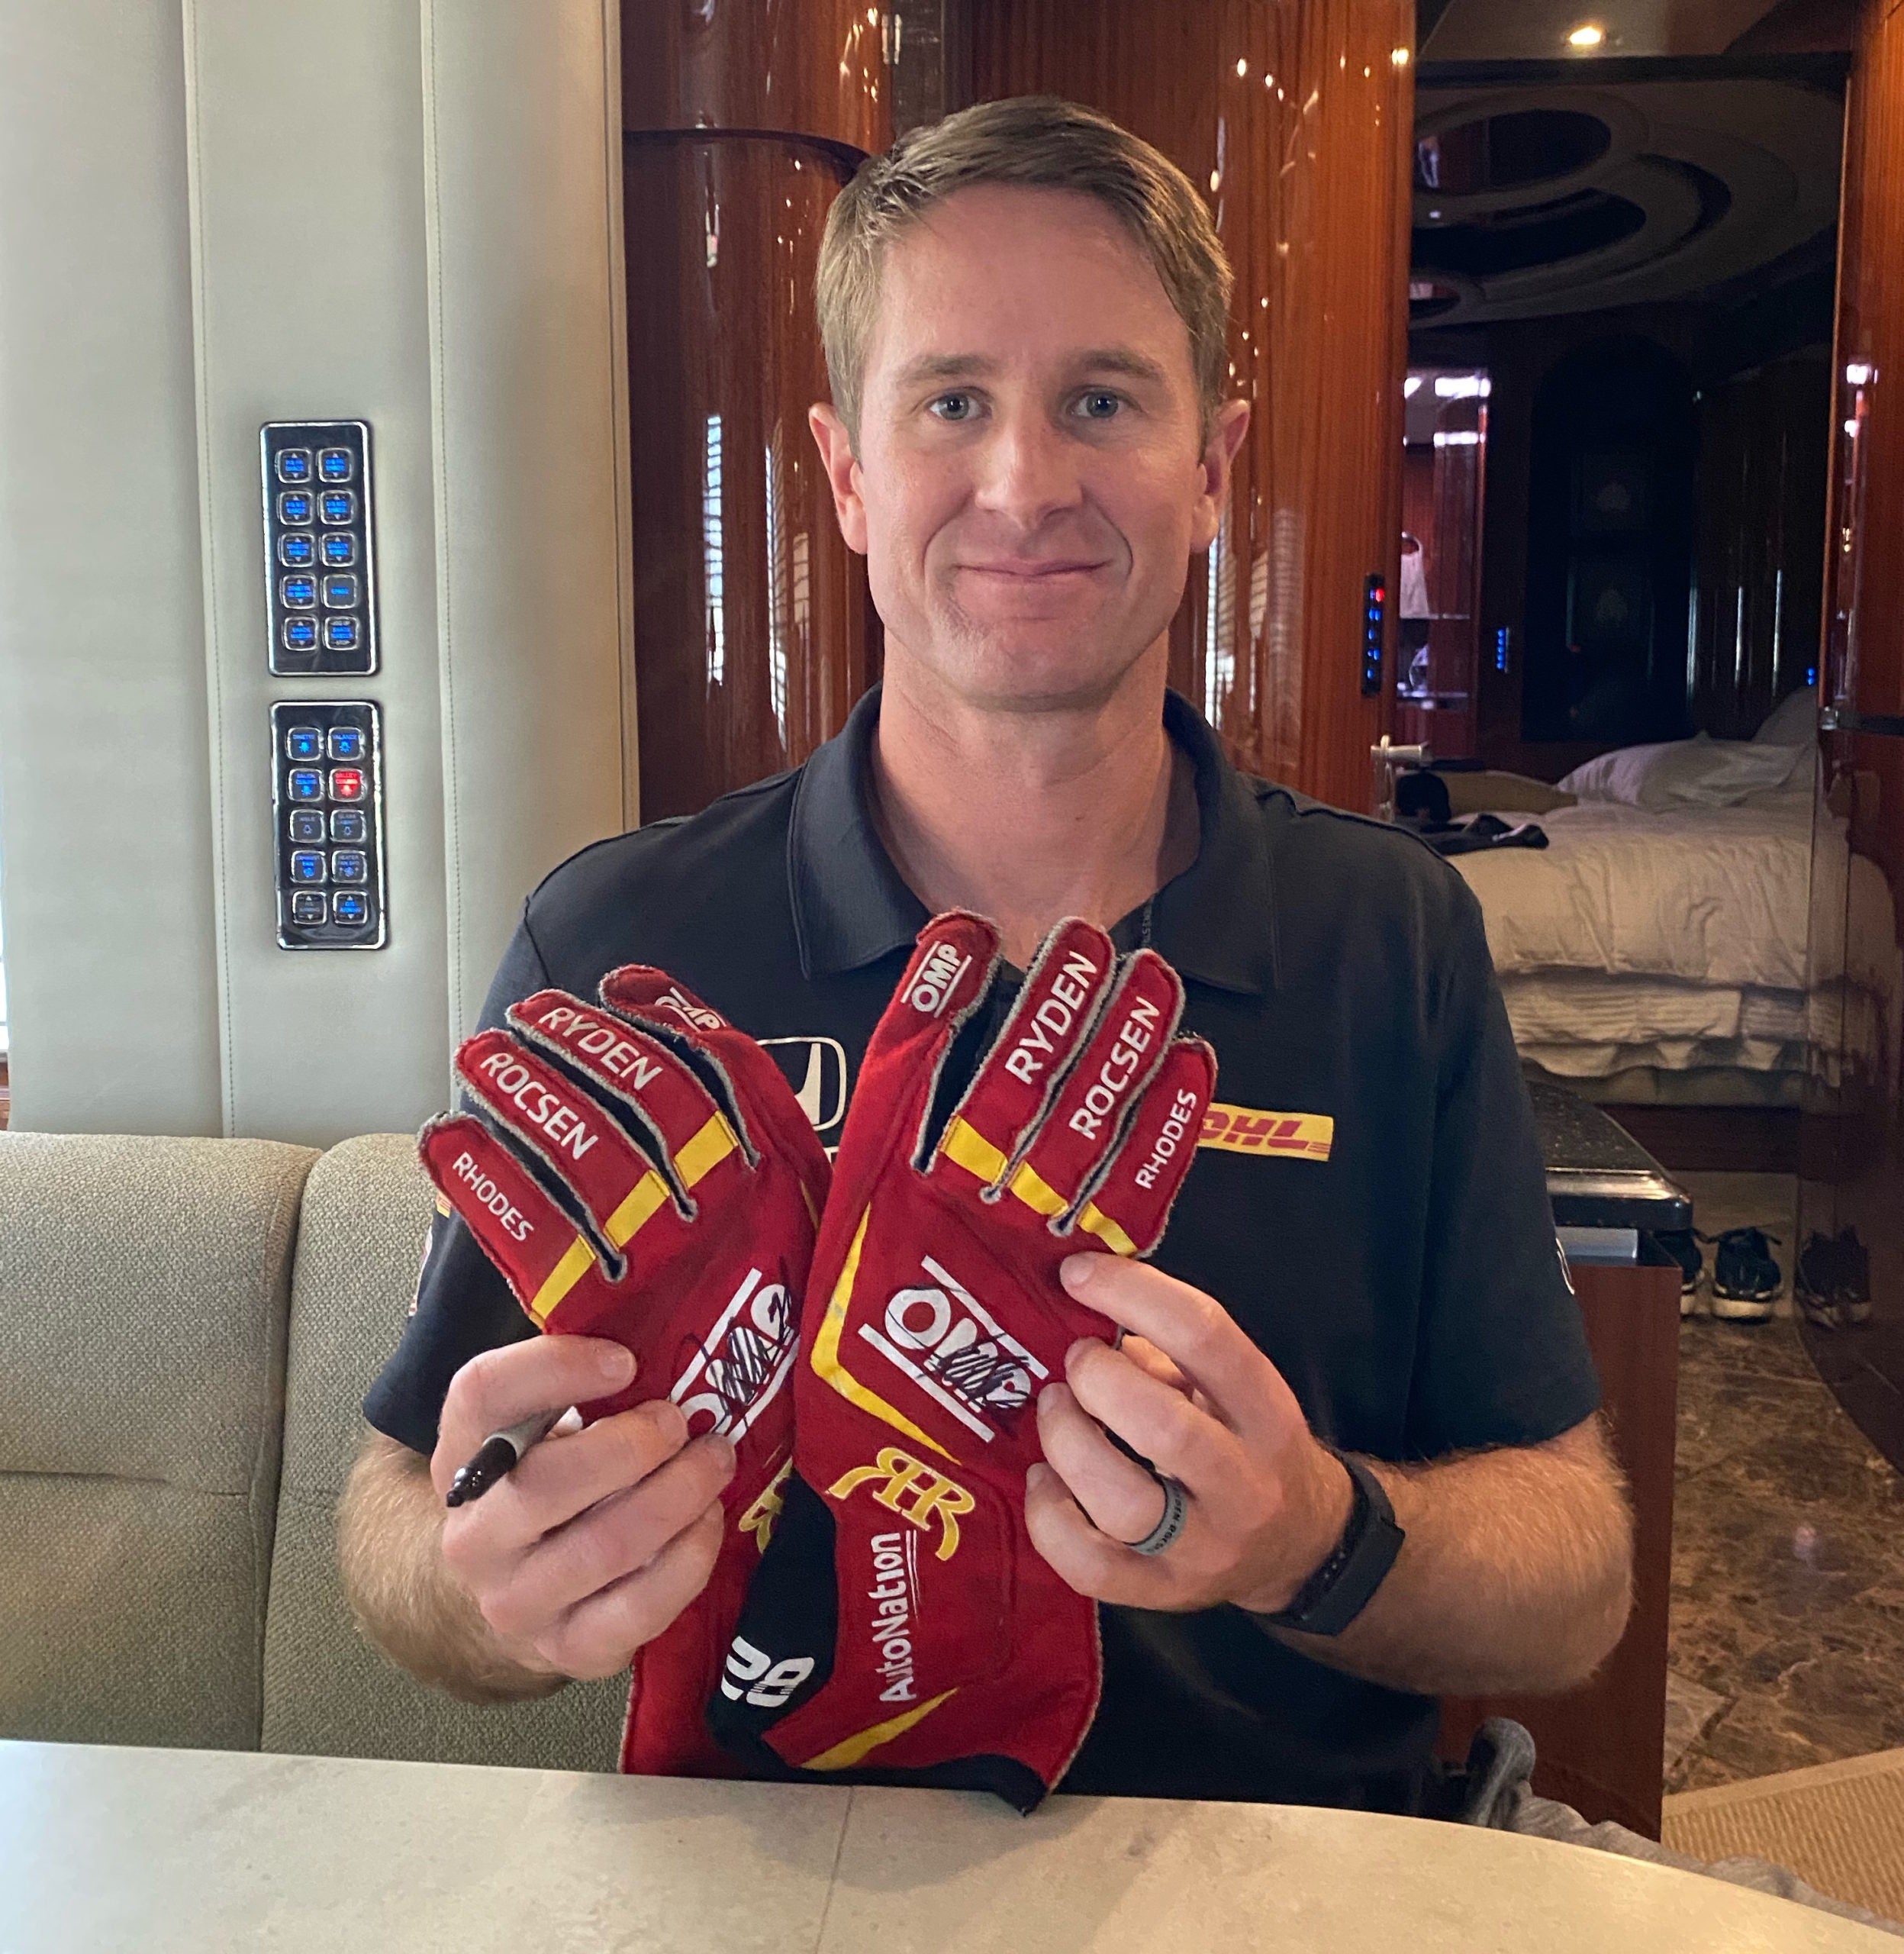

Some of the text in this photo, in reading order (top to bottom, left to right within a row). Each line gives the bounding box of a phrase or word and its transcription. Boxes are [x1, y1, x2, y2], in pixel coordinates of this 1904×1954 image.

[911, 943, 962, 1012] OMP
[1004, 950, 1097, 1085] RYDEN
[538, 1007, 663, 1091] RYDEN
[1068, 996, 1160, 1140] ROCSEN
[480, 1053, 599, 1160] ROCSEN
[1135, 1088, 1197, 1189] RHODES
[1198, 1111, 1310, 1151] DHL
[452, 1151, 535, 1241] RHODES
[868, 1532, 914, 1702] AutoNation
[720, 1636, 814, 1707] 28
